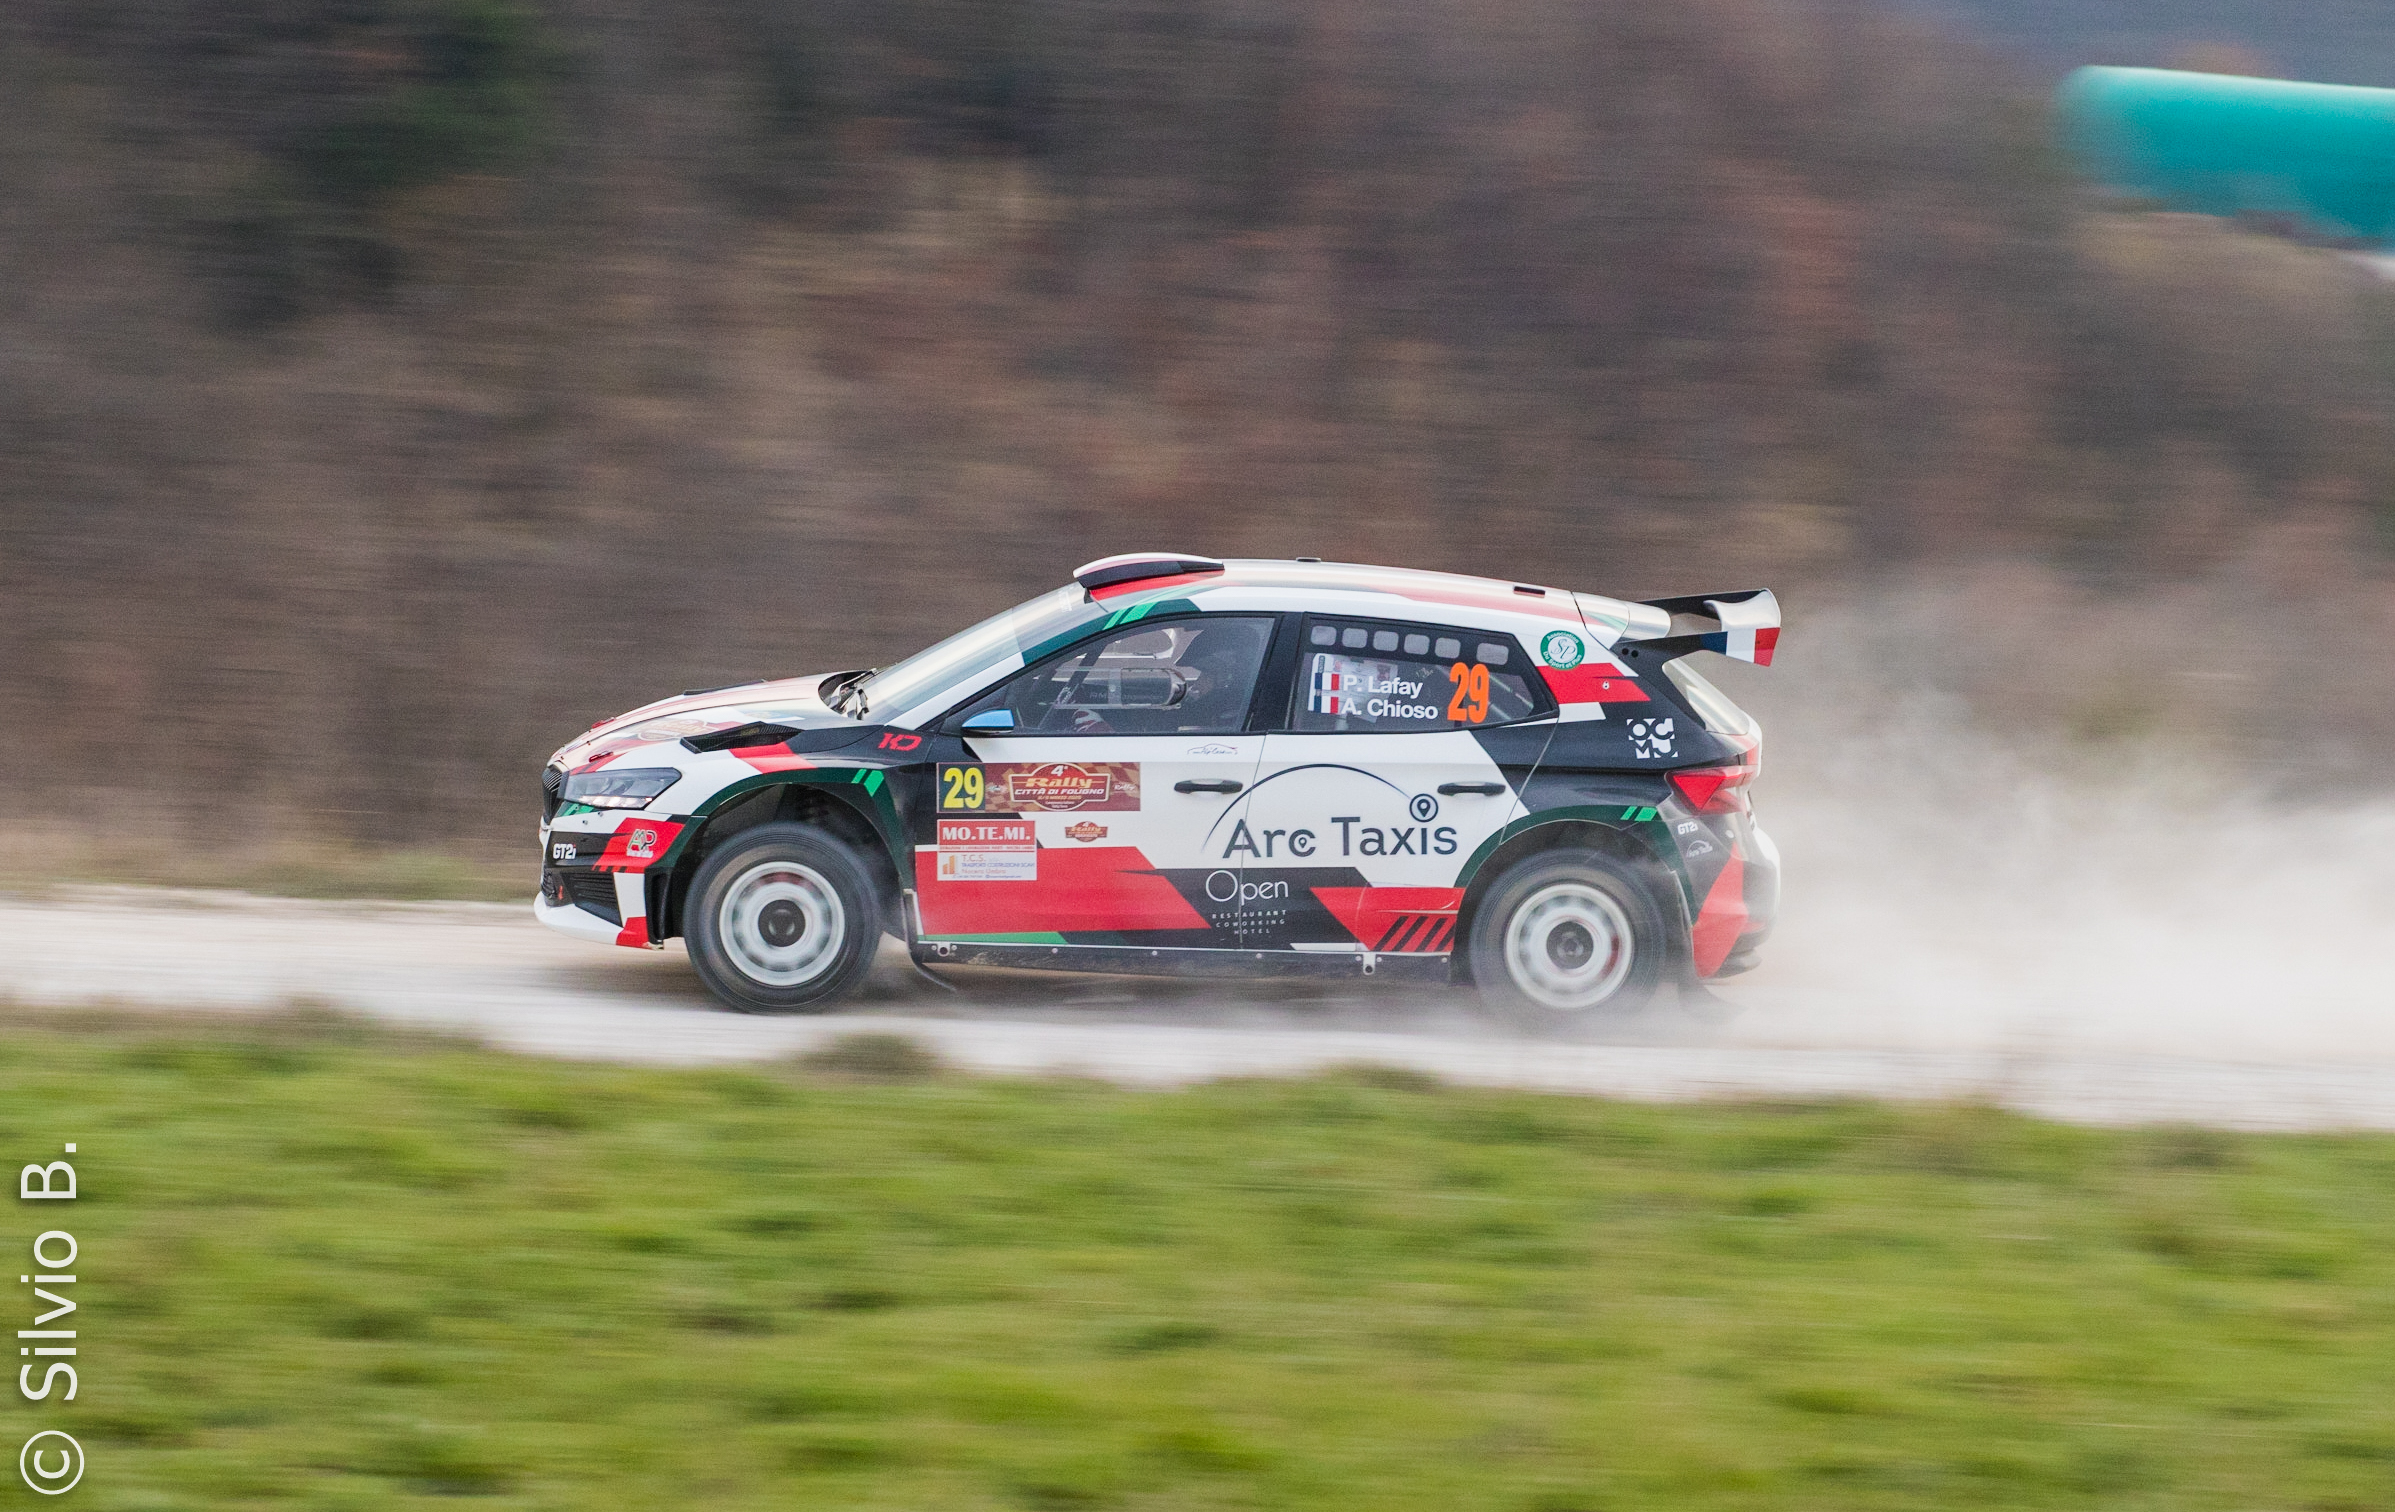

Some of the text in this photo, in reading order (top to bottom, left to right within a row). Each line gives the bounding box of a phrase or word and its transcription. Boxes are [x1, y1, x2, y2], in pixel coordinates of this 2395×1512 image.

[1343, 674, 1423, 699] P. Lafay
[1447, 662, 1490, 724] 29
[1341, 697, 1438, 720] A. Chioso
[943, 767, 985, 809] 29
[1025, 777, 1093, 788] Rally
[942, 827, 1031, 840] MO.TE.MI.
[1222, 816, 1458, 857] Arc Taxis
[553, 843, 577, 860] GT2i
[961, 854, 986, 862] T.C.S.
[1205, 869, 1289, 906] Open
[1211, 909, 1287, 919] RESTAURANT
[1215, 919, 1285, 928] COWORKING
